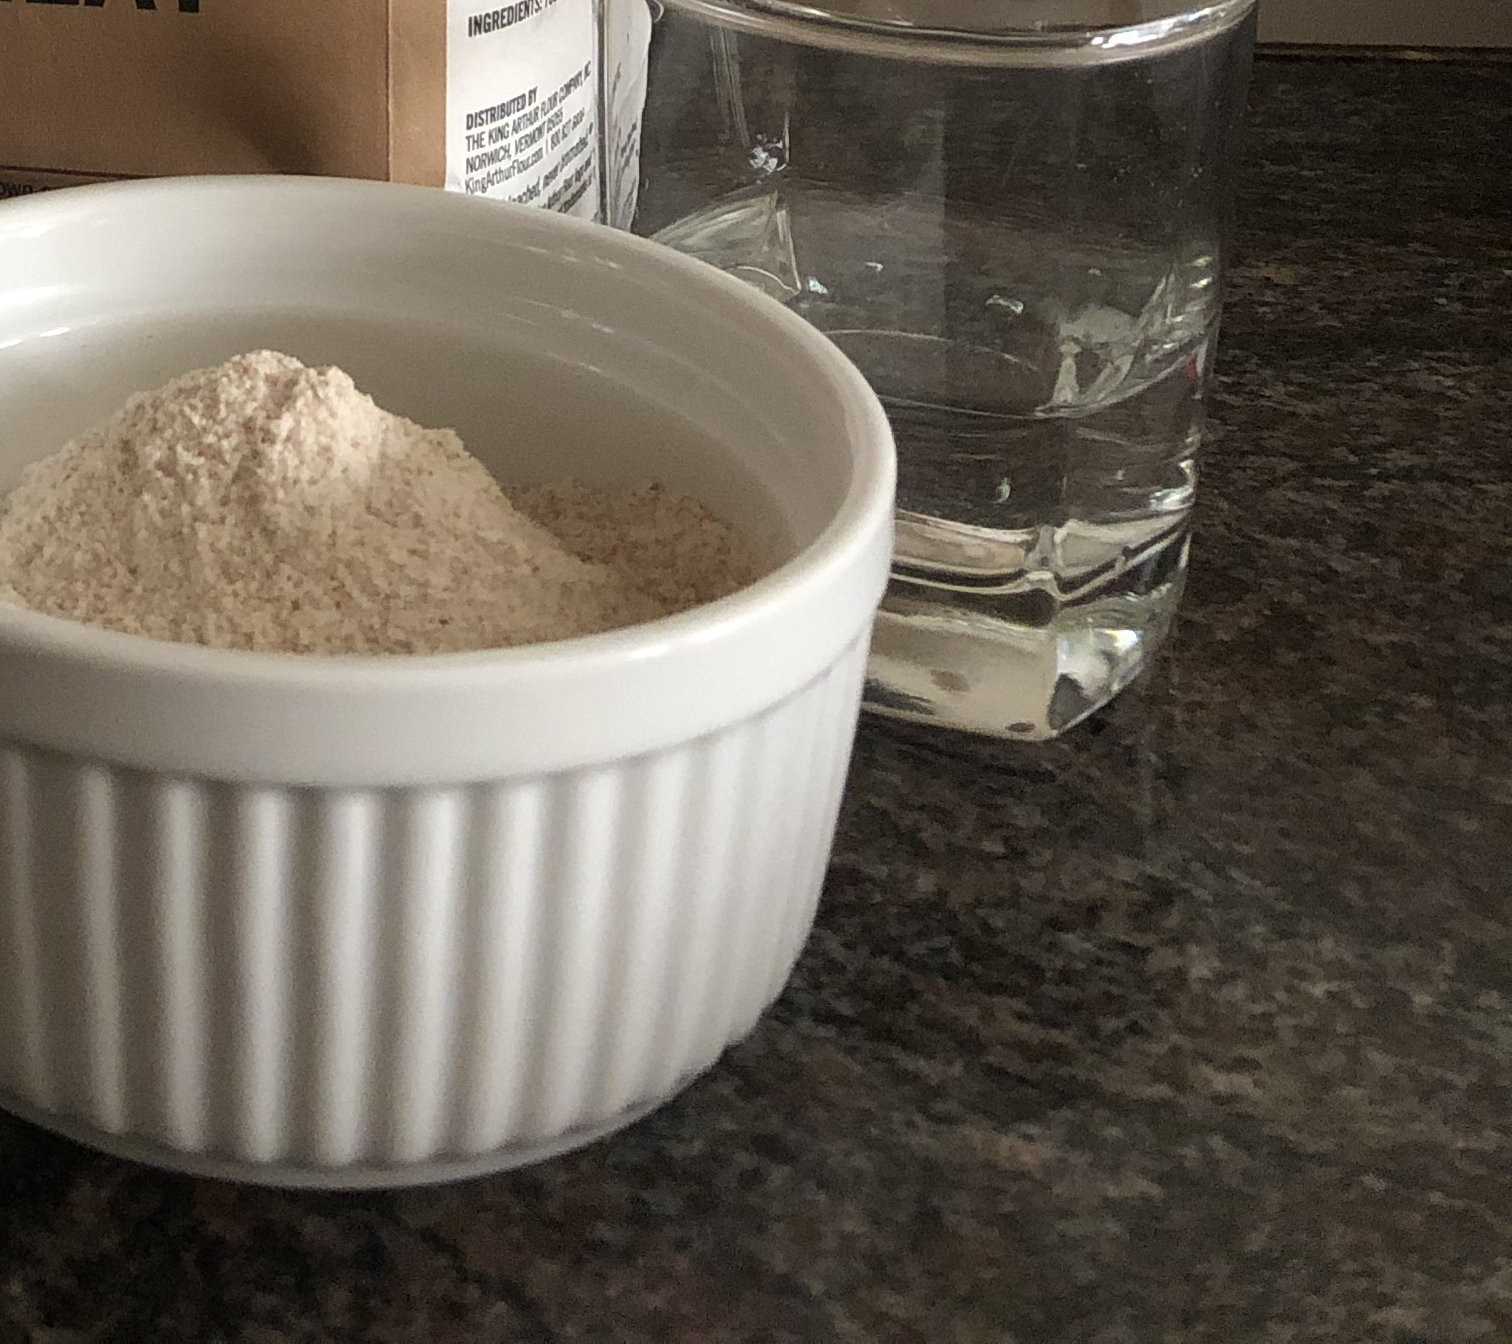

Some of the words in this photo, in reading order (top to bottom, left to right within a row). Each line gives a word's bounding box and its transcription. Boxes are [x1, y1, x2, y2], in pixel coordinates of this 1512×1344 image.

[465, 92, 527, 131] DISTRIBUTED
[527, 85, 539, 107] BY
[465, 130, 487, 153] THE
[487, 122, 510, 147] KING
[510, 105, 540, 136] ARTHUR
